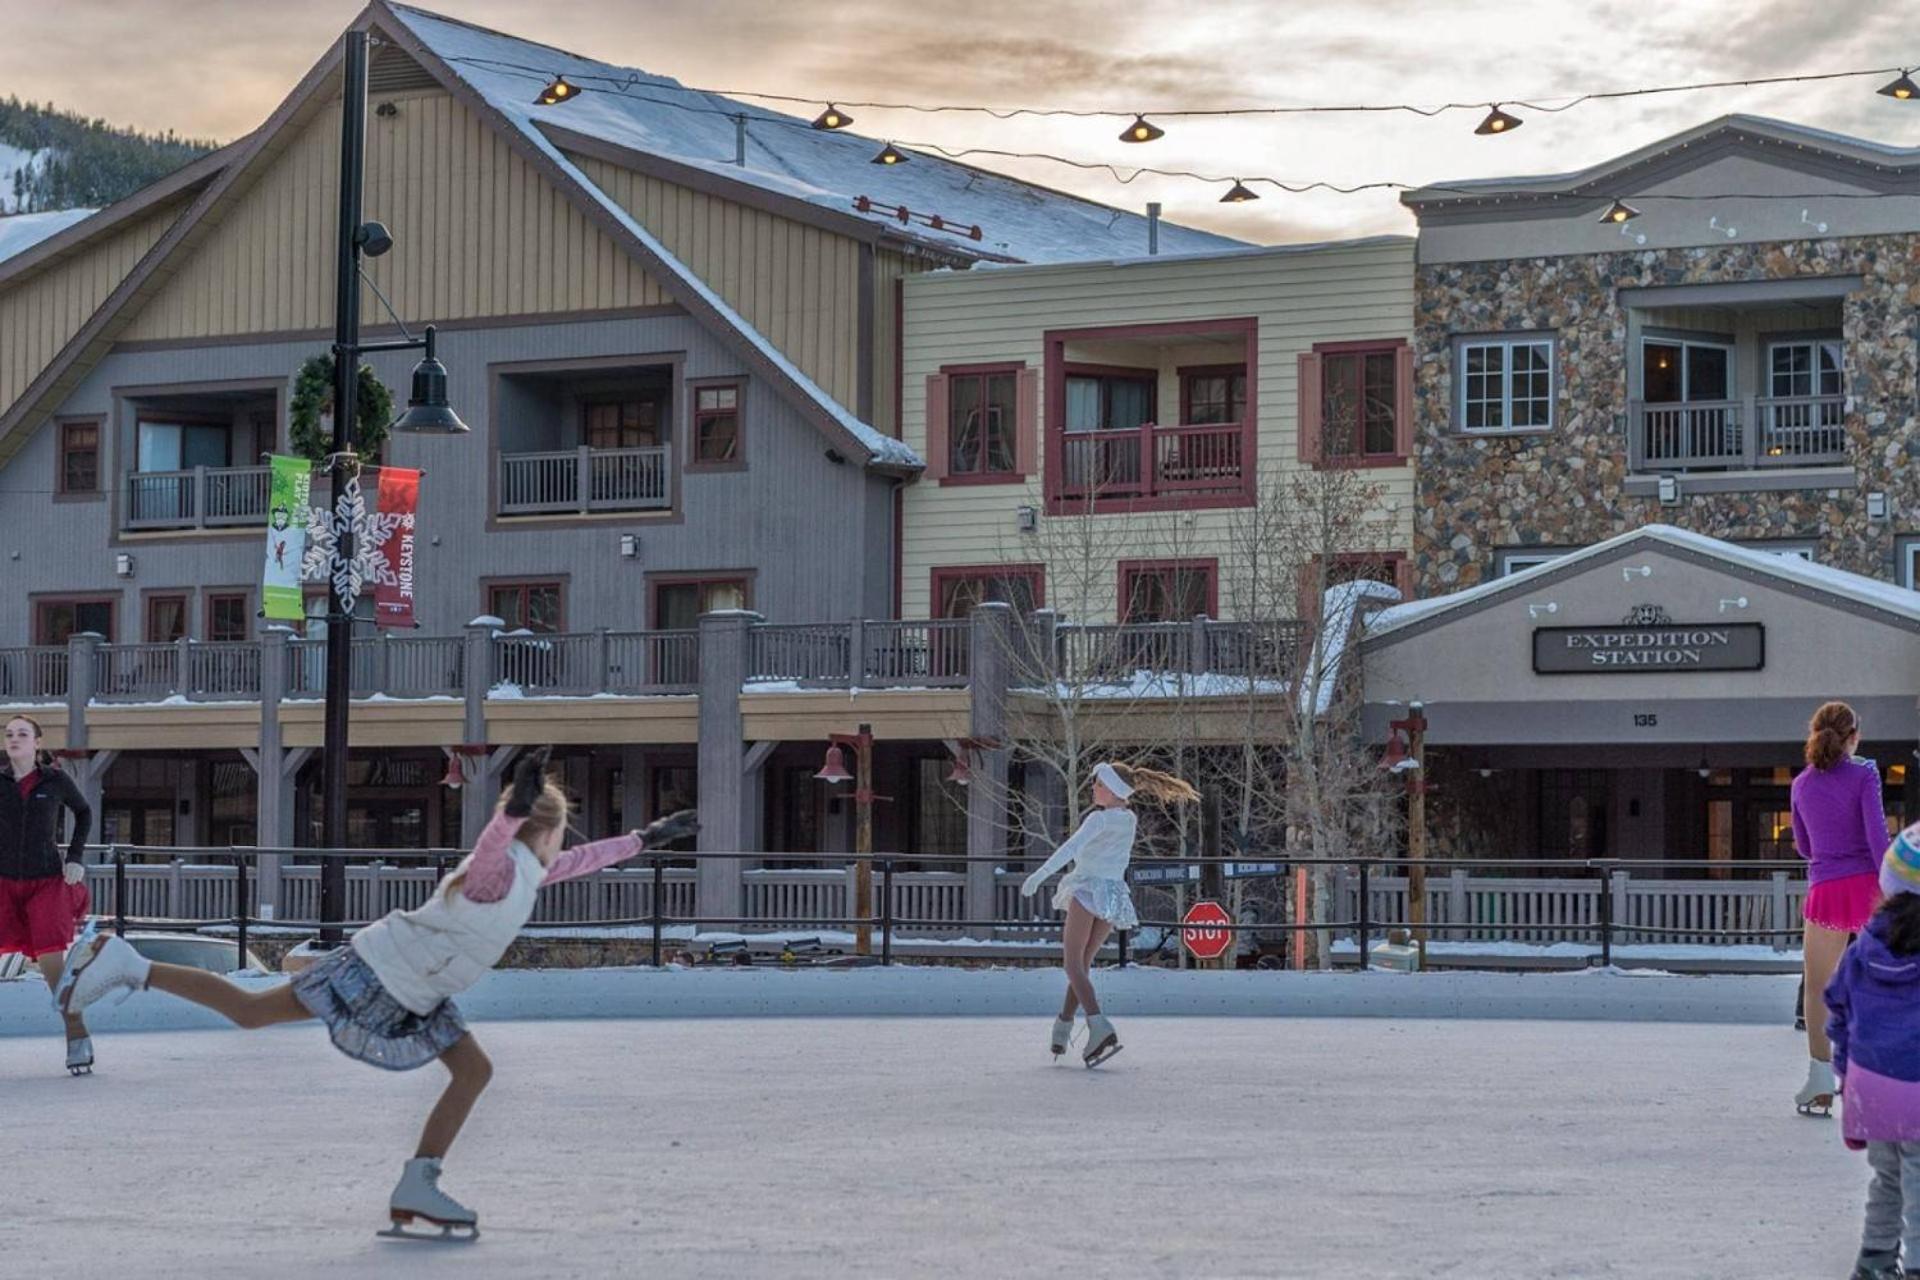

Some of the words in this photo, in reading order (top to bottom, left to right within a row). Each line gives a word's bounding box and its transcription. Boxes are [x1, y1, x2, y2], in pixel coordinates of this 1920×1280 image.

[400, 534, 415, 598] KEYSTONE
[1566, 630, 1730, 648] EXPEDITION
[1592, 650, 1701, 665] STATION
[1633, 714, 1657, 727] 135
[1187, 919, 1227, 941] STOP
